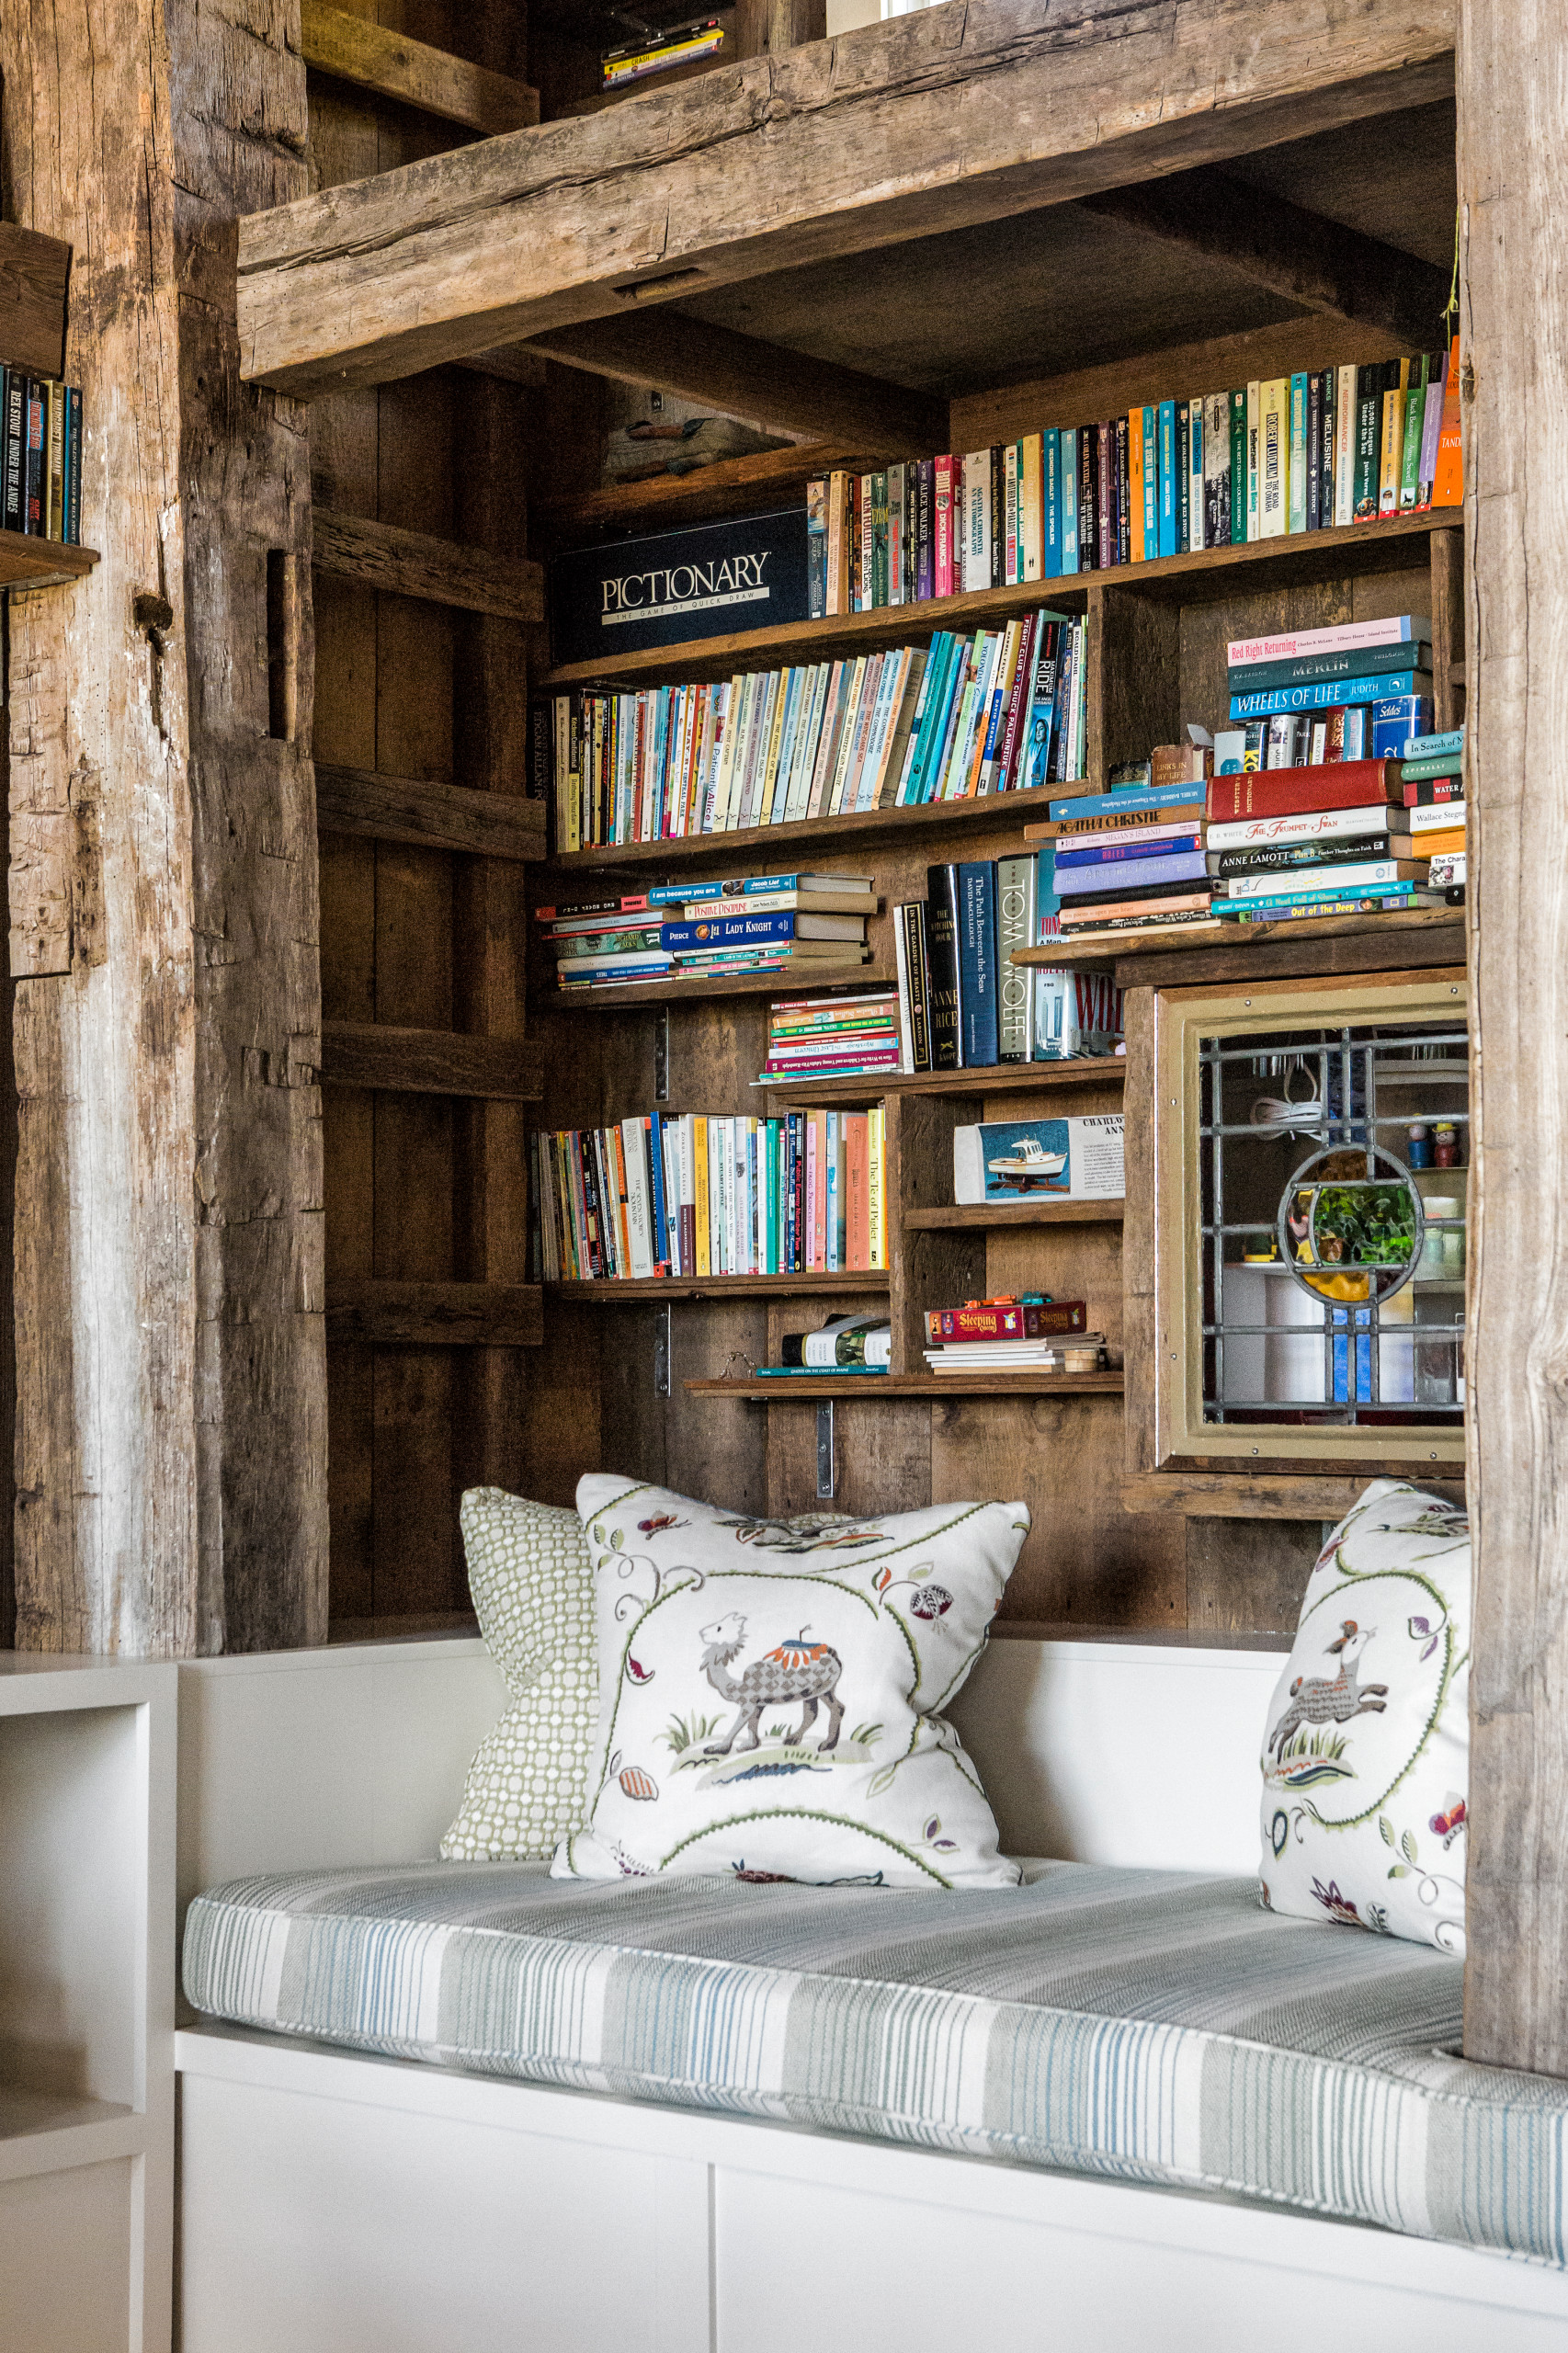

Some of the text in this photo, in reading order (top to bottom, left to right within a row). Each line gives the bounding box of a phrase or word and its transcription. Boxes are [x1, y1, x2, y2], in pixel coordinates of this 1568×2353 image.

[631, 56, 649, 66] CRASH
[1341, 390, 1349, 452] NEUROMANCER
[29, 436, 41, 449] EGG
[51, 398, 62, 475] MARGARET TRUMAN
[1267, 414, 1278, 478] ROBERT LUDLUM
[1324, 415, 1332, 472] MELUSINE
[1366, 427, 1375, 456] Leagues
[1405, 398, 1417, 483] Black Beauty Anna Sewell
[7, 391, 21, 513] REX STOUT UNDER THE ANDES
[936, 471, 950, 494] BOLT
[971, 488, 977, 497] AN
[1266, 482, 1272, 490] TO
[1249, 492, 1257, 512] Dickey
[1271, 492, 1279, 508] ROAD
[601, 551, 768, 612] PICTIONARY
[616, 612, 632, 621] THE
[641, 607, 665, 617] GAME
[691, 597, 721, 608] QUICK
[729, 592, 755, 602] DRAW
[1232, 639, 1297, 660] Red Right Returning
[854, 667, 862, 688] PATRICK
[1035, 661, 1050, 693] RIDE
[1292, 660, 1349, 676] MERLIN
[850, 689, 858, 710] O'BRIAN
[1001, 620, 1029, 767] FIGHT CLUB CHUCK PALAHNIUK
[1237, 683, 1379, 712] WHEELS OF LIFE JUDITH
[1379, 705, 1401, 718] Seldes
[987, 699, 1000, 750] DAVID SEDARIS
[842, 726, 852, 753] THIRTEEN
[1411, 739, 1456, 753] In Search of
[835, 767, 845, 786] SALUTE
[1156, 763, 1176, 771] LINKS
[1170, 771, 1187, 779] LIFE
[1405, 764, 1445, 774] SPINELLI
[1435, 785, 1460, 794] WATER
[1056, 810, 1162, 834] AGATHA CHRISTIE
[1416, 810, 1465, 823] Wallace Stegne
[1105, 828, 1161, 841] MEGAN'S ISLAND
[1244, 815, 1338, 839] THE TRUMPET SWAN
[1222, 857, 1248, 867] ANNE
[1250, 852, 1289, 865] LAMOTT
[1294, 849, 1309, 859] Plan
[695, 903, 748, 918] POSITIVE DISCIPLINE
[1290, 903, 1355, 917] Out of the Deep
[669, 932, 689, 940] PIERCE
[725, 921, 772, 935] LADY KNIGHT
[975, 877, 986, 994] The Path Between the Seas
[1040, 916, 1061, 936] TOM
[1002, 879, 1026, 1038] TOM WOLFE
[913, 966, 919, 974] OF
[1083, 1118, 1122, 1127] CHARLO
[869, 1157, 879, 1240] The Te of Piglet
[959, 1313, 996, 1329] Sleeping
[1040, 1311, 1067, 1324] Sleeping
